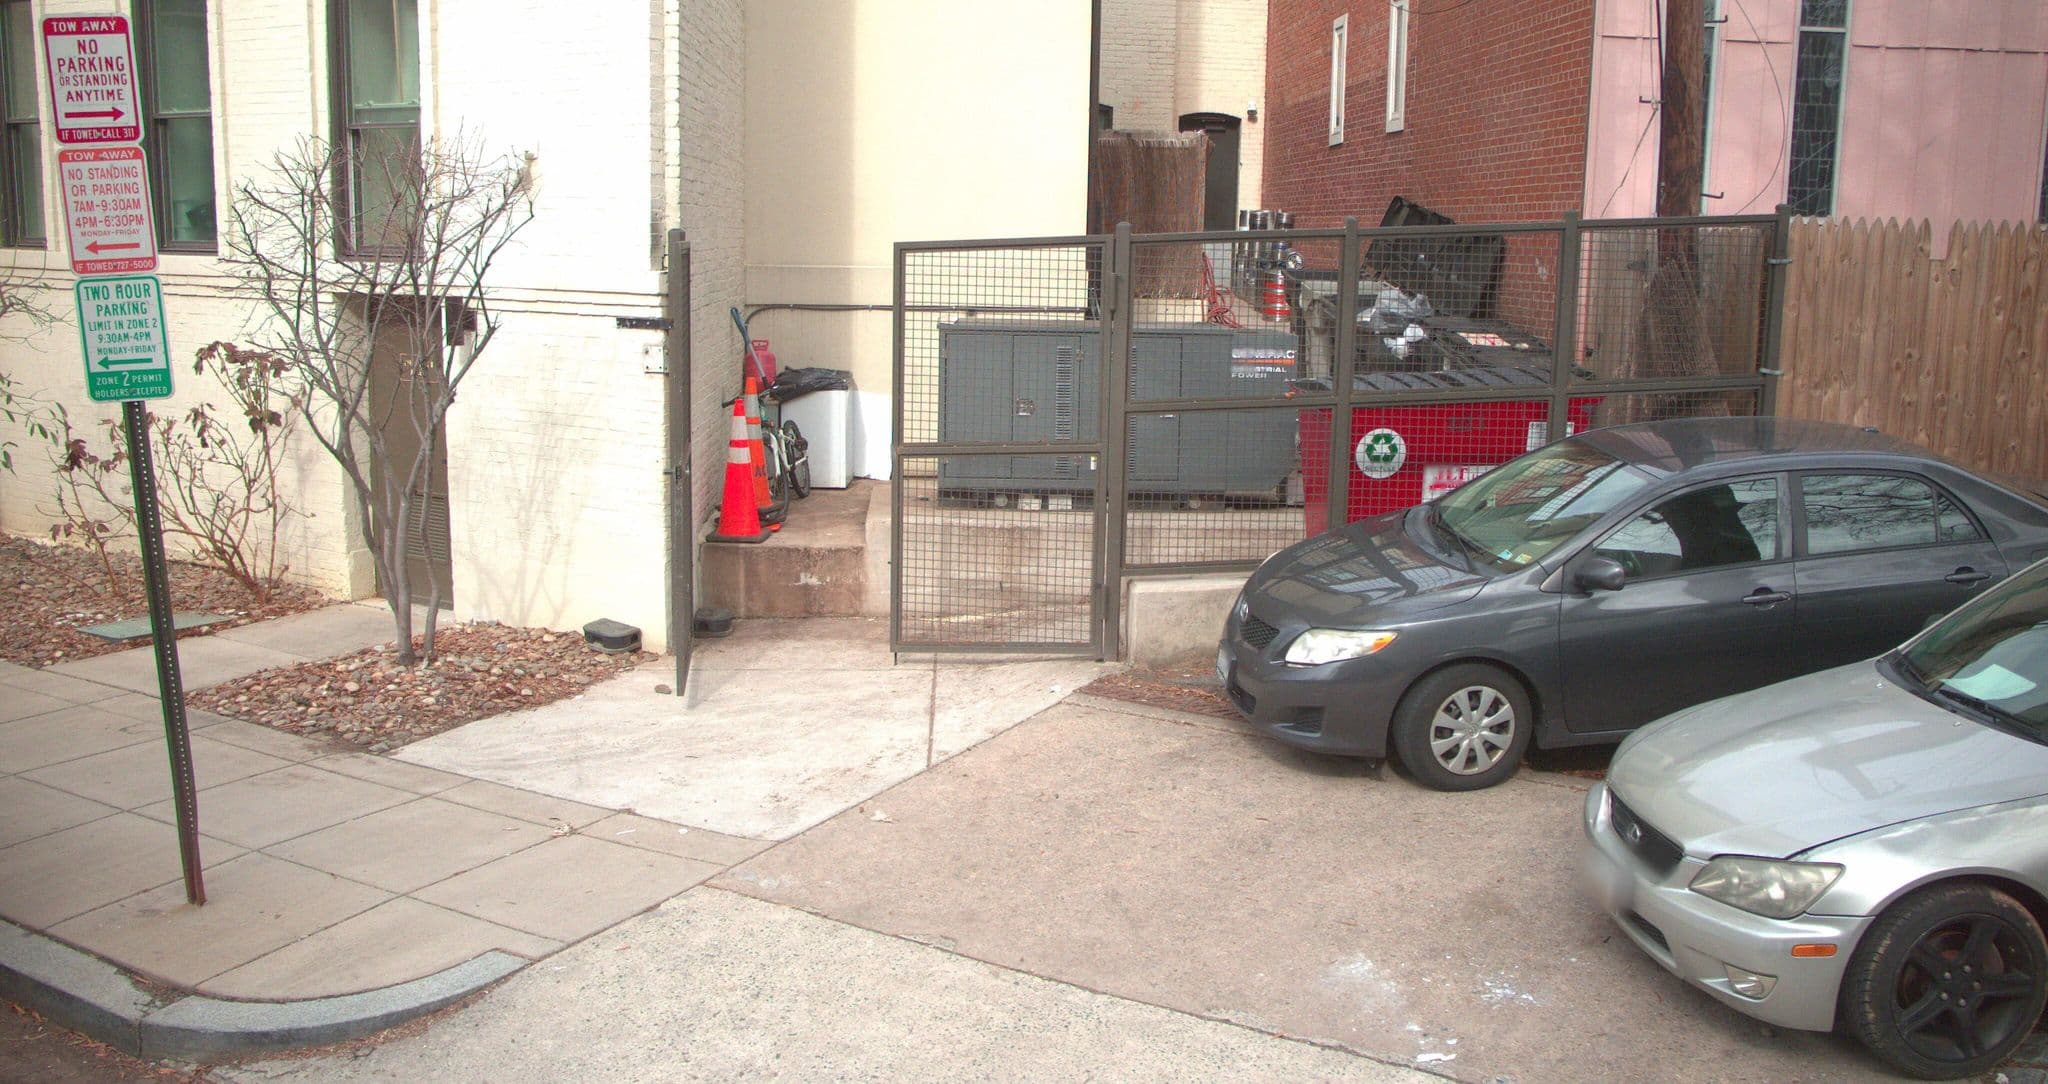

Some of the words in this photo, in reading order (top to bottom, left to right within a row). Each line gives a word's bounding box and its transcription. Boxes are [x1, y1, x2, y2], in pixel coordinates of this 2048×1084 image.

[52, 22, 76, 32] TOW
[82, 21, 116, 32] AWAY
[77, 40, 98, 54] NO
[58, 56, 124, 72] PARKING
[60, 76, 70, 86] OR
[73, 74, 128, 86] STANDING
[66, 89, 125, 102] ANYTIME
[62, 130, 69, 140] IF
[72, 130, 98, 139] TOWED
[102, 128, 120, 138] CALL
[124, 128, 134, 137] 311
[66, 152, 94, 160] TOW
[68, 169, 82, 180] NO
[88, 166, 138, 180] STANDING
[72, 185, 87, 196] OR
[92, 182, 139, 196] PARKING
[74, 199, 141, 212] 7AM-9:30AM
[75, 214, 144, 228] 4PM-6:30PM
[81, 229, 140, 237] MONDAY-FRIDAY
[87, 262, 113, 271] TOWED
[84, 285, 109, 300] TWO
[116, 284, 151, 299] HOUR
[96, 302, 148, 316] PARKING
[88, 320, 111, 331] LIMIT
[115, 320, 124, 329] IN
[128, 319, 150, 329] ZONE
[152, 318, 158, 328] 2
[98, 331, 151, 343] 9:30AM-4PM
[97, 344, 156, 355] MONDAY-FRIDAY
[96, 377, 118, 386] ZONE
[122, 372, 130, 386] 2
[132, 374, 162, 383] PERMIT
[95, 388, 129, 398] HOLDERS
